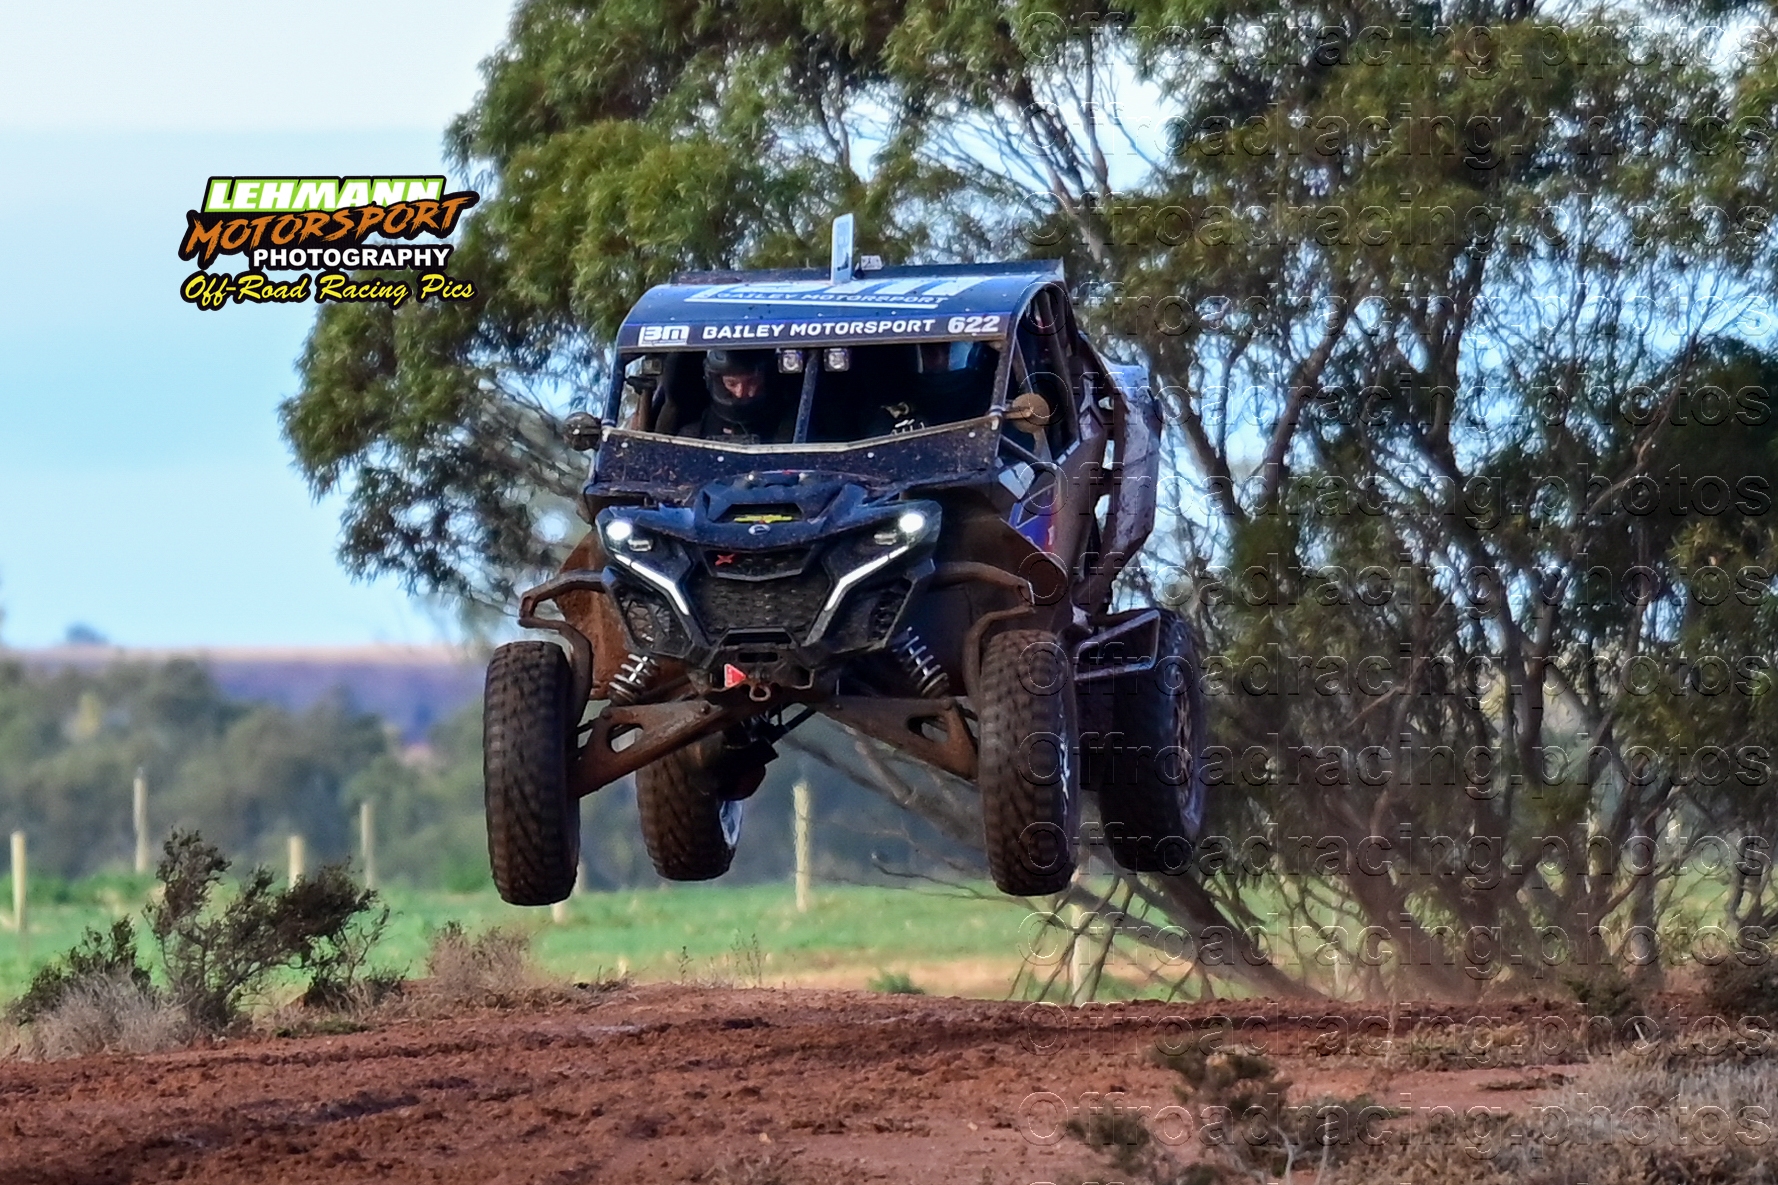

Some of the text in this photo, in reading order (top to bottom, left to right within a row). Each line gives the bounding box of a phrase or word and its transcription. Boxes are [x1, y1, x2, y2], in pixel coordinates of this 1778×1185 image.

[702, 323, 785, 340] BAILEY
[789, 319, 936, 337] MOTORSPORT
[947, 315, 1001, 334] 622
